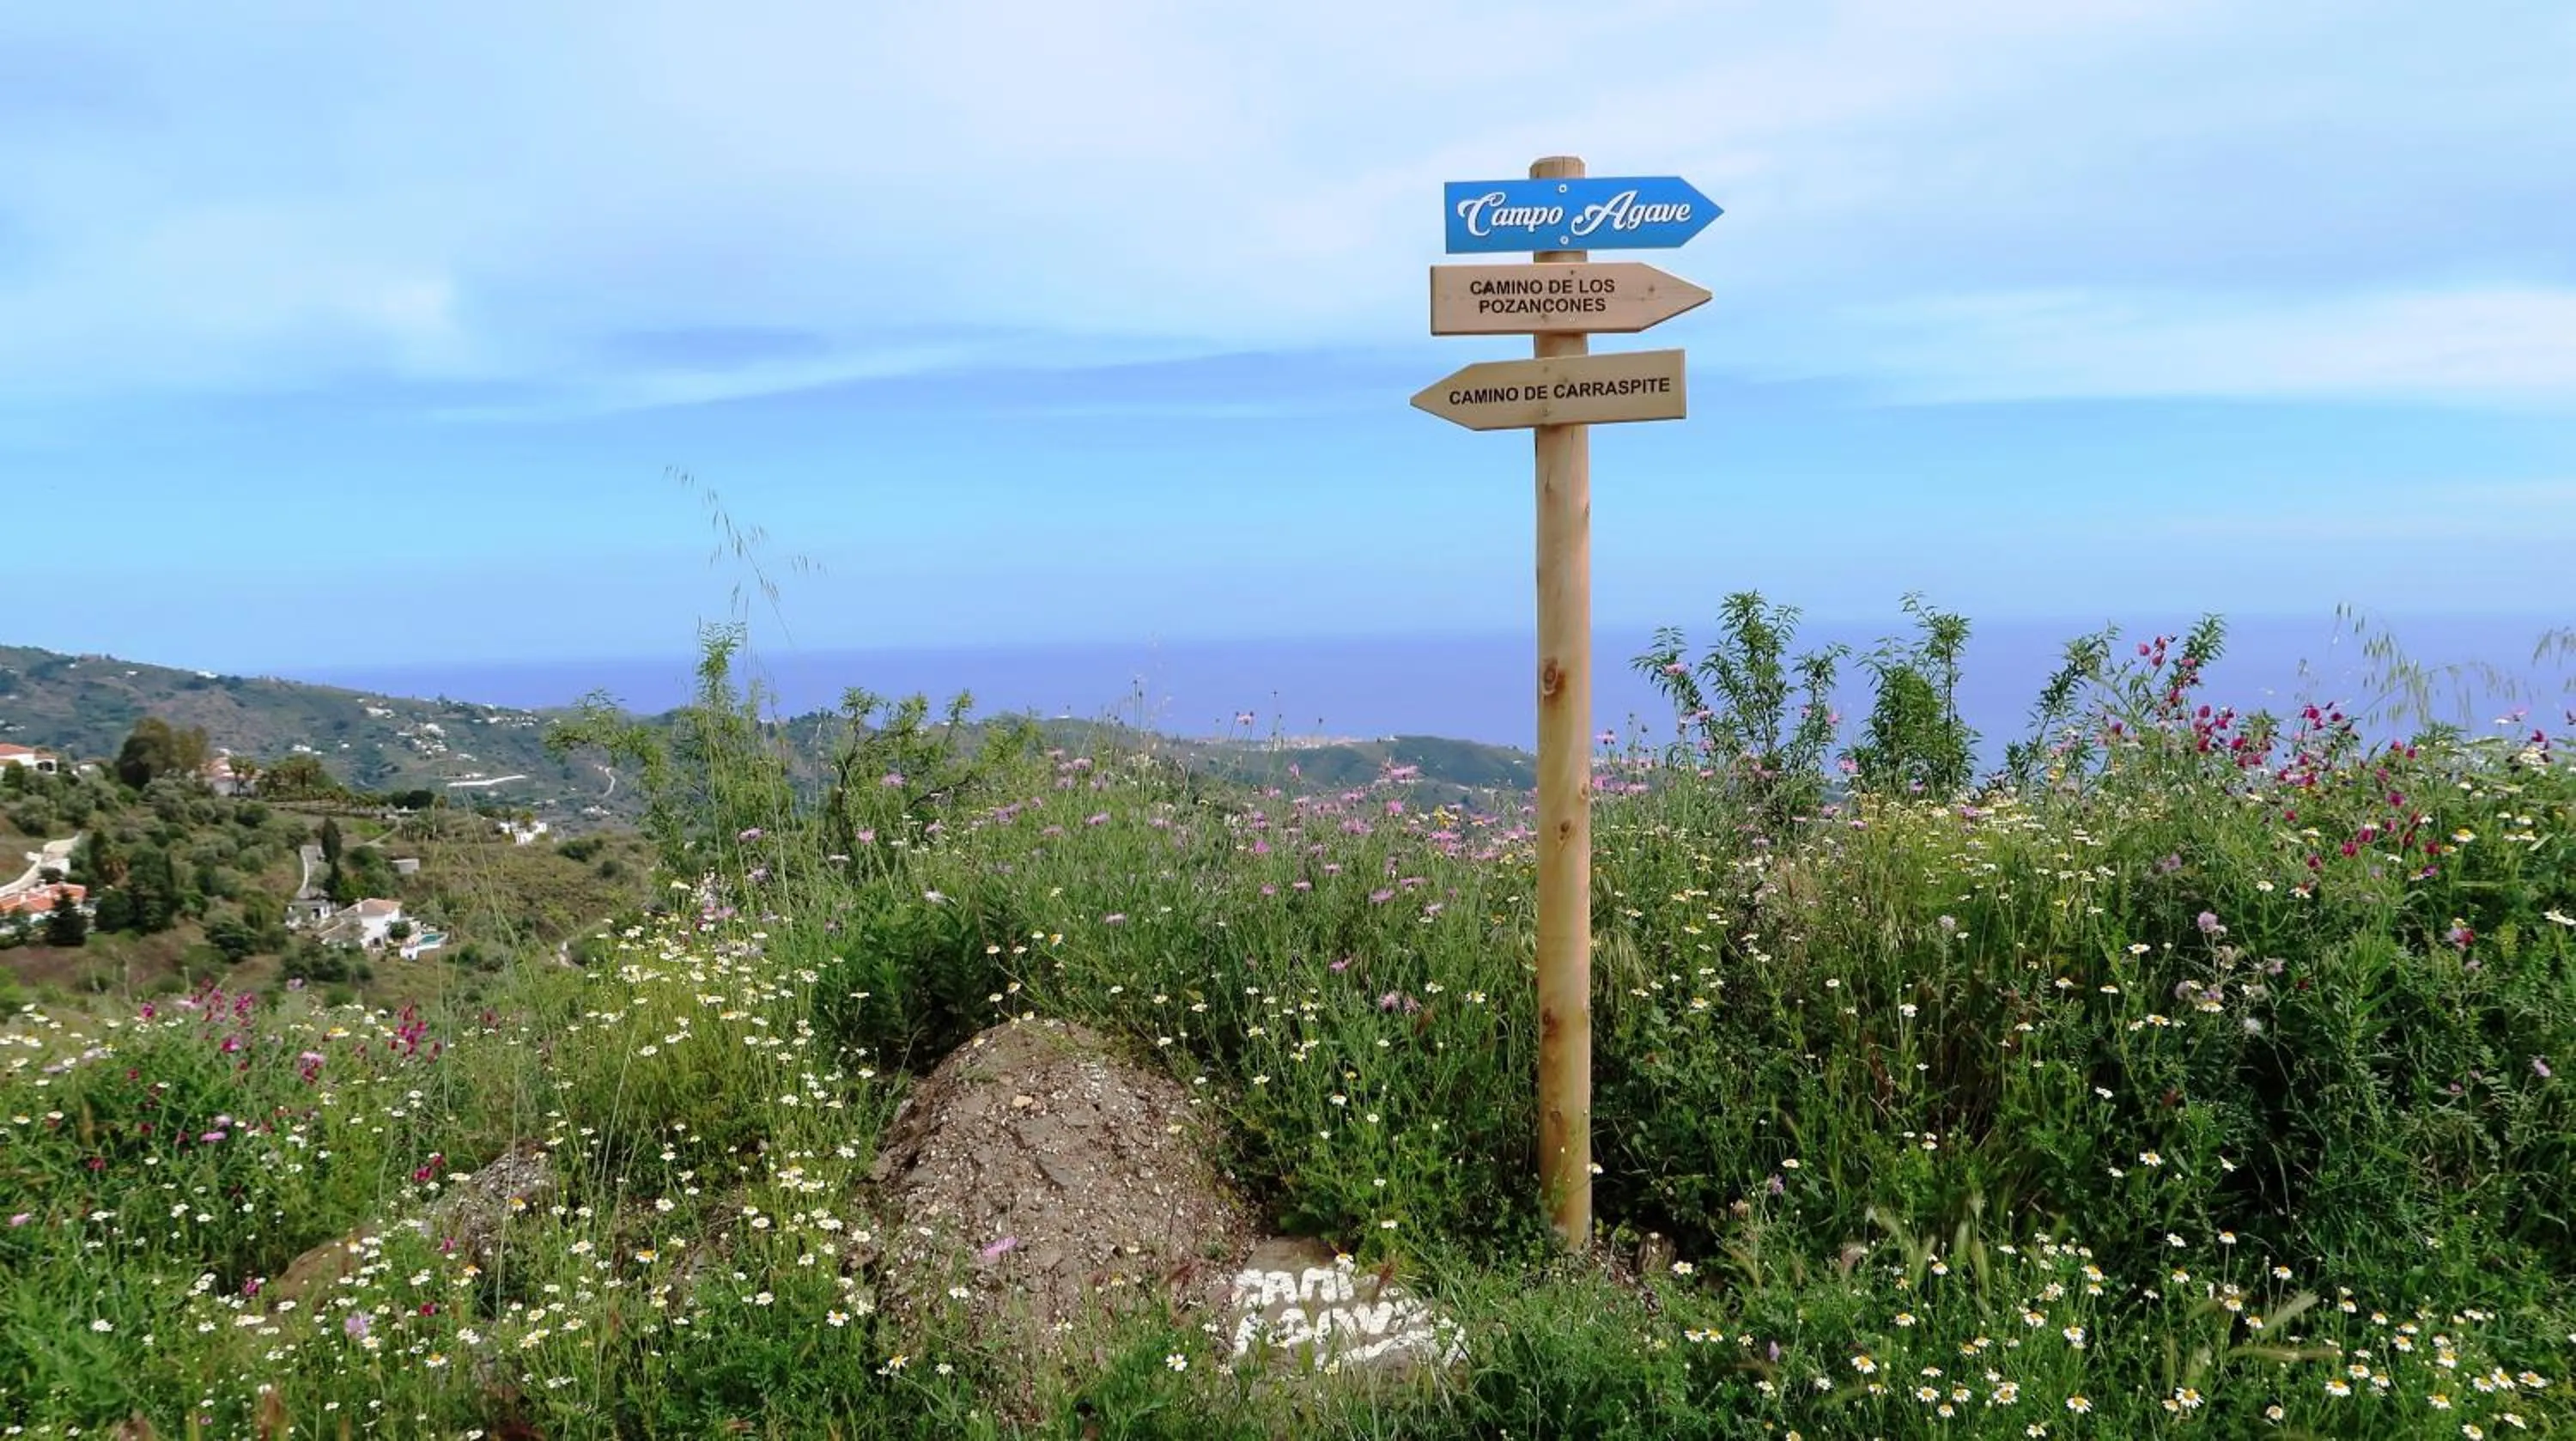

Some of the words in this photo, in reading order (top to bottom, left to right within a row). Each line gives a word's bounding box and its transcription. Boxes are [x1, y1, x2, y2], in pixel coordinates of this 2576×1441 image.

[1457, 192, 1564, 236] Campo
[1571, 190, 1692, 236] Agave
[1469, 280, 1543, 295] CAMINO
[1548, 280, 1573, 294] DE
[1578, 279, 1616, 294] LOS
[1479, 298, 1607, 314] POZANCONES
[1449, 386, 1519, 406] CAMINO
[1523, 385, 1548, 401] DE
[1552, 377, 1671, 399] CARRASPITE
